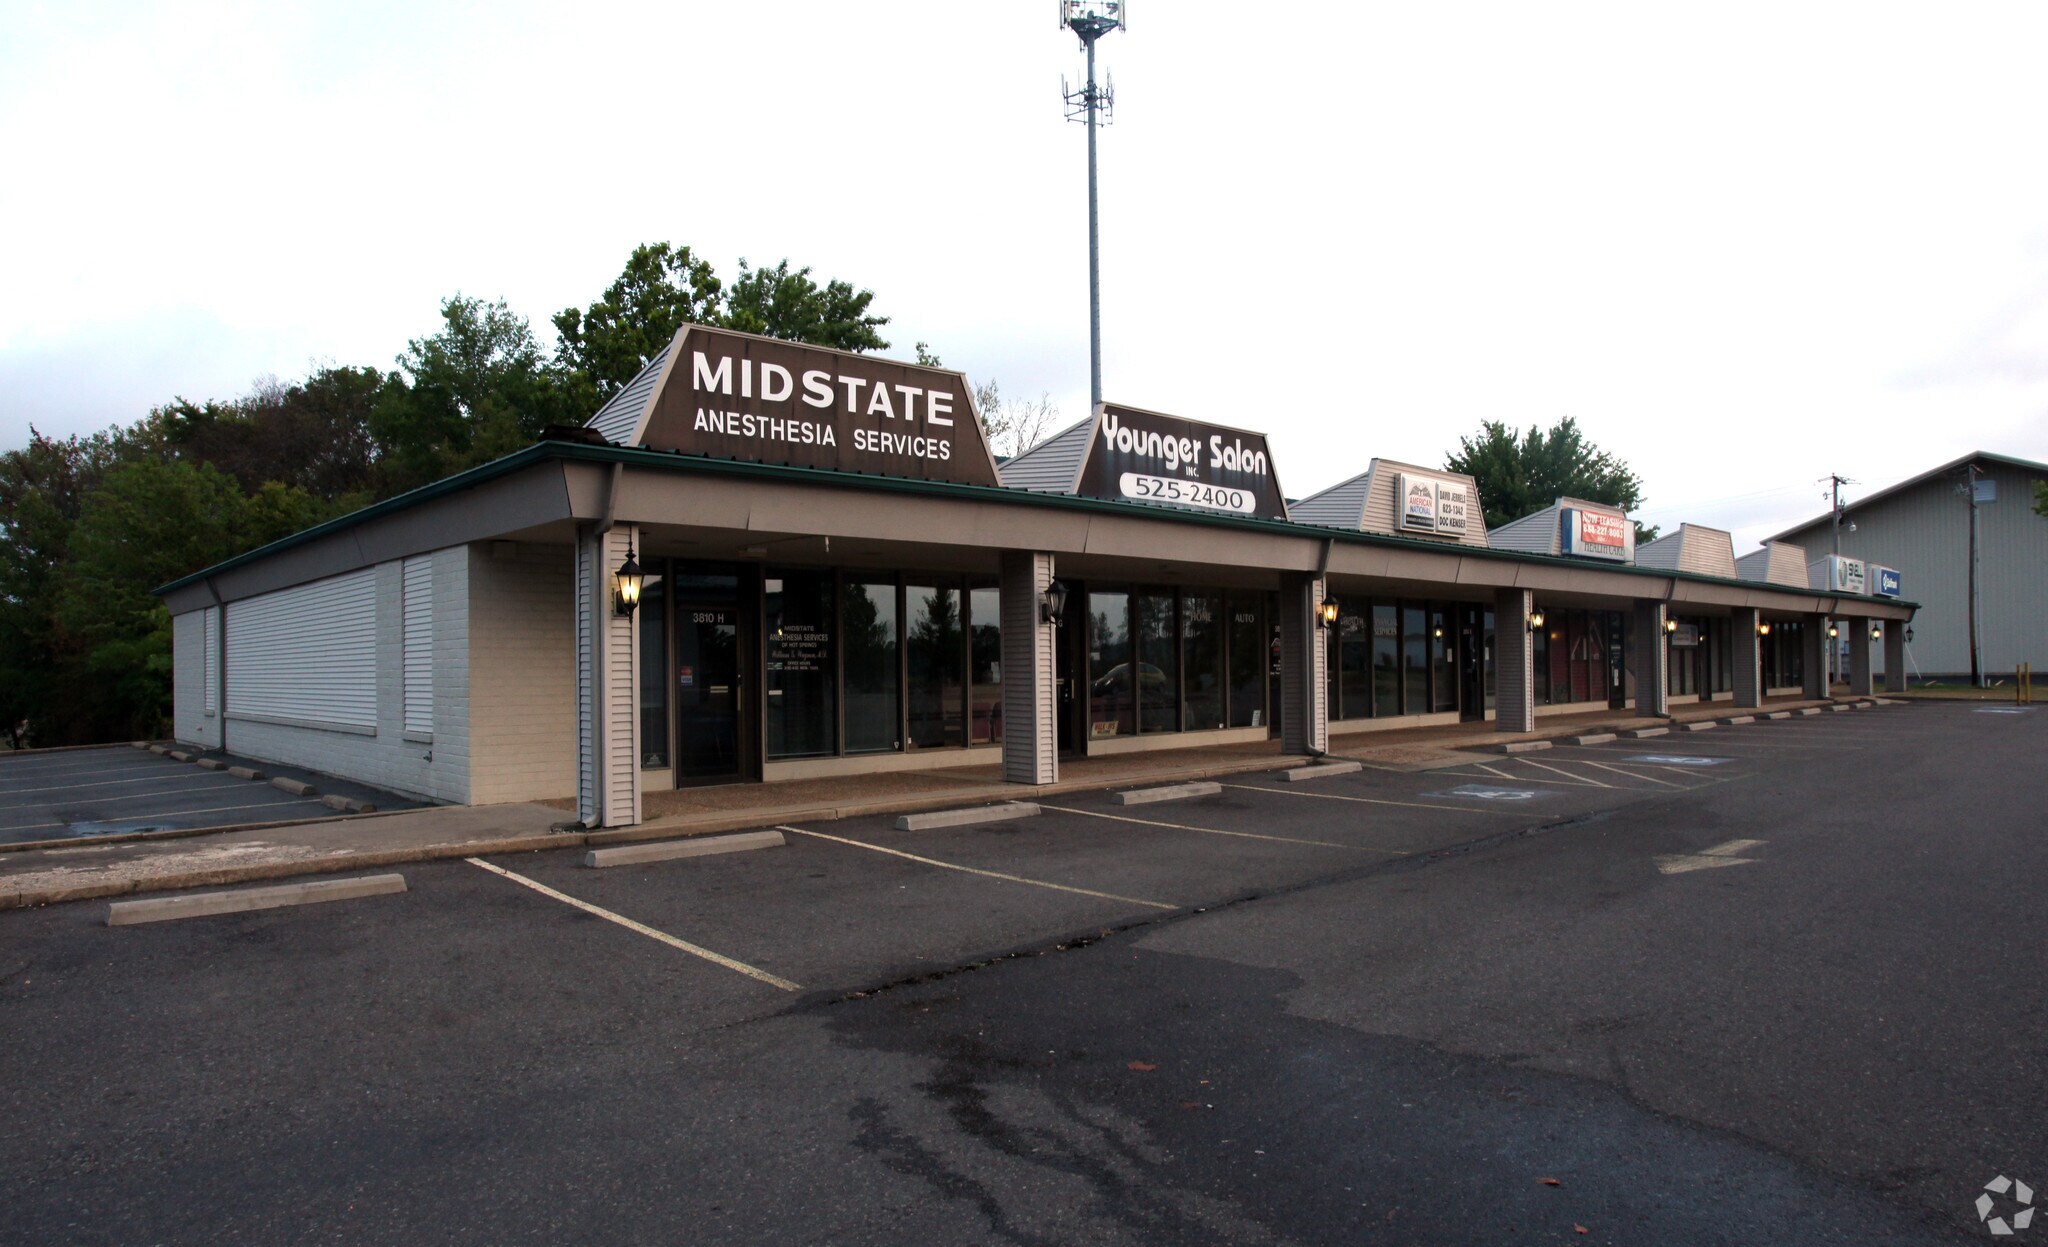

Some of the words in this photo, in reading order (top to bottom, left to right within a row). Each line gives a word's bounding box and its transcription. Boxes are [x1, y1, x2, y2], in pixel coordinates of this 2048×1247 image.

[693, 351, 954, 427] MIDSTATE
[694, 408, 836, 447] ANESTHESIA
[854, 429, 951, 460] SERVICES
[1102, 413, 1202, 470] Younger
[1209, 435, 1267, 475] Salon
[1136, 478, 1243, 509] 525-2400
[1439, 490, 1451, 501] DAVID
[1409, 497, 1432, 508] AMERICAN
[1409, 505, 1431, 516] NATIONAL
[1439, 516, 1449, 526] DOC
[1599, 515, 1624, 528] LEASING
[1584, 542, 1608, 554] HEALTH
[692, 612, 714, 623] 3810
[717, 612, 725, 623] H
[1190, 612, 1212, 623] HOME
[1234, 613, 1255, 623] AUTO
[768, 633, 803, 642] ANESTHESIA
[803, 634, 829, 642] SERVICES
